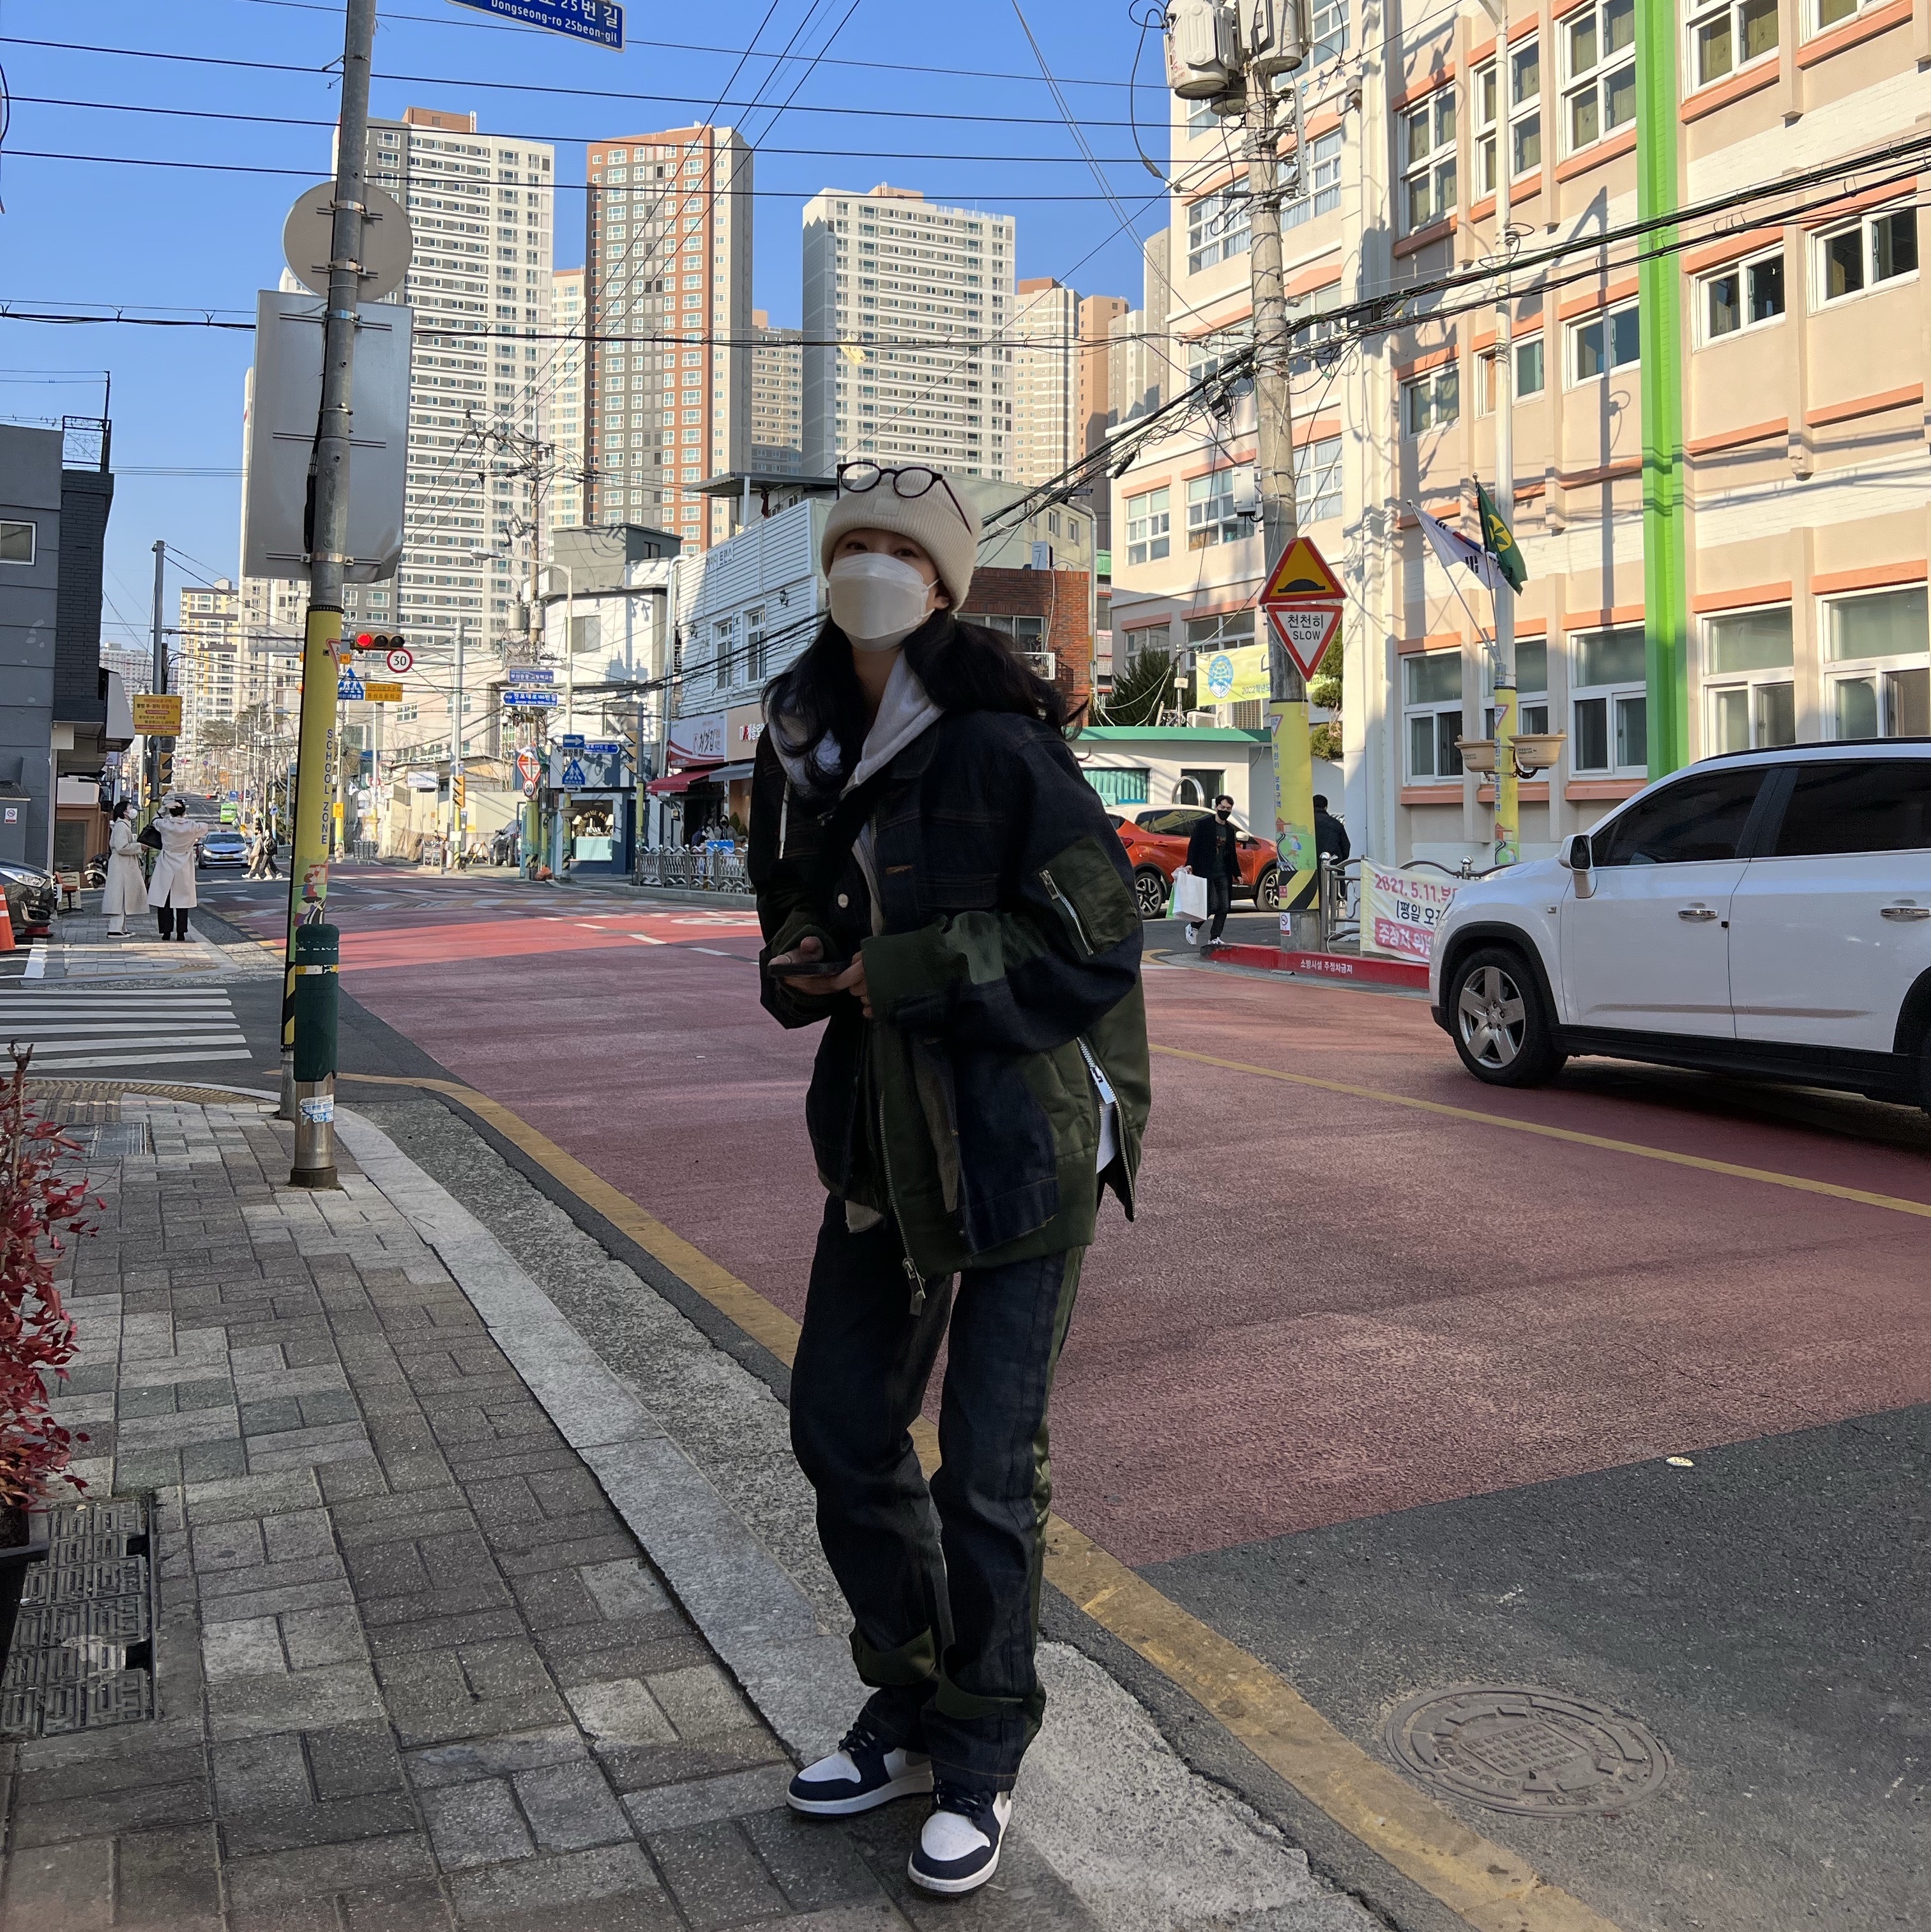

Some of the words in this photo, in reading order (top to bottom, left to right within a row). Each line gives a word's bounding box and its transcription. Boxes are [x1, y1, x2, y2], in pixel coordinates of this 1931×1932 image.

[491, 0, 562, 26] Dongseong-ro
[564, 18, 617, 43] 25beon-gil
[1287, 614, 1324, 628] 천천히
[1293, 630, 1321, 640] SLOW
[393, 655, 407, 666] 30
[324, 729, 333, 795] SCHOOL
[1375, 873, 1407, 897] 2021.
[1397, 900, 1420, 923] (평일
[1379, 923, 1411, 950] 주정차
[1300, 960, 1322, 970] 소방시설
[1324, 961, 1352, 974] 주정차금지
